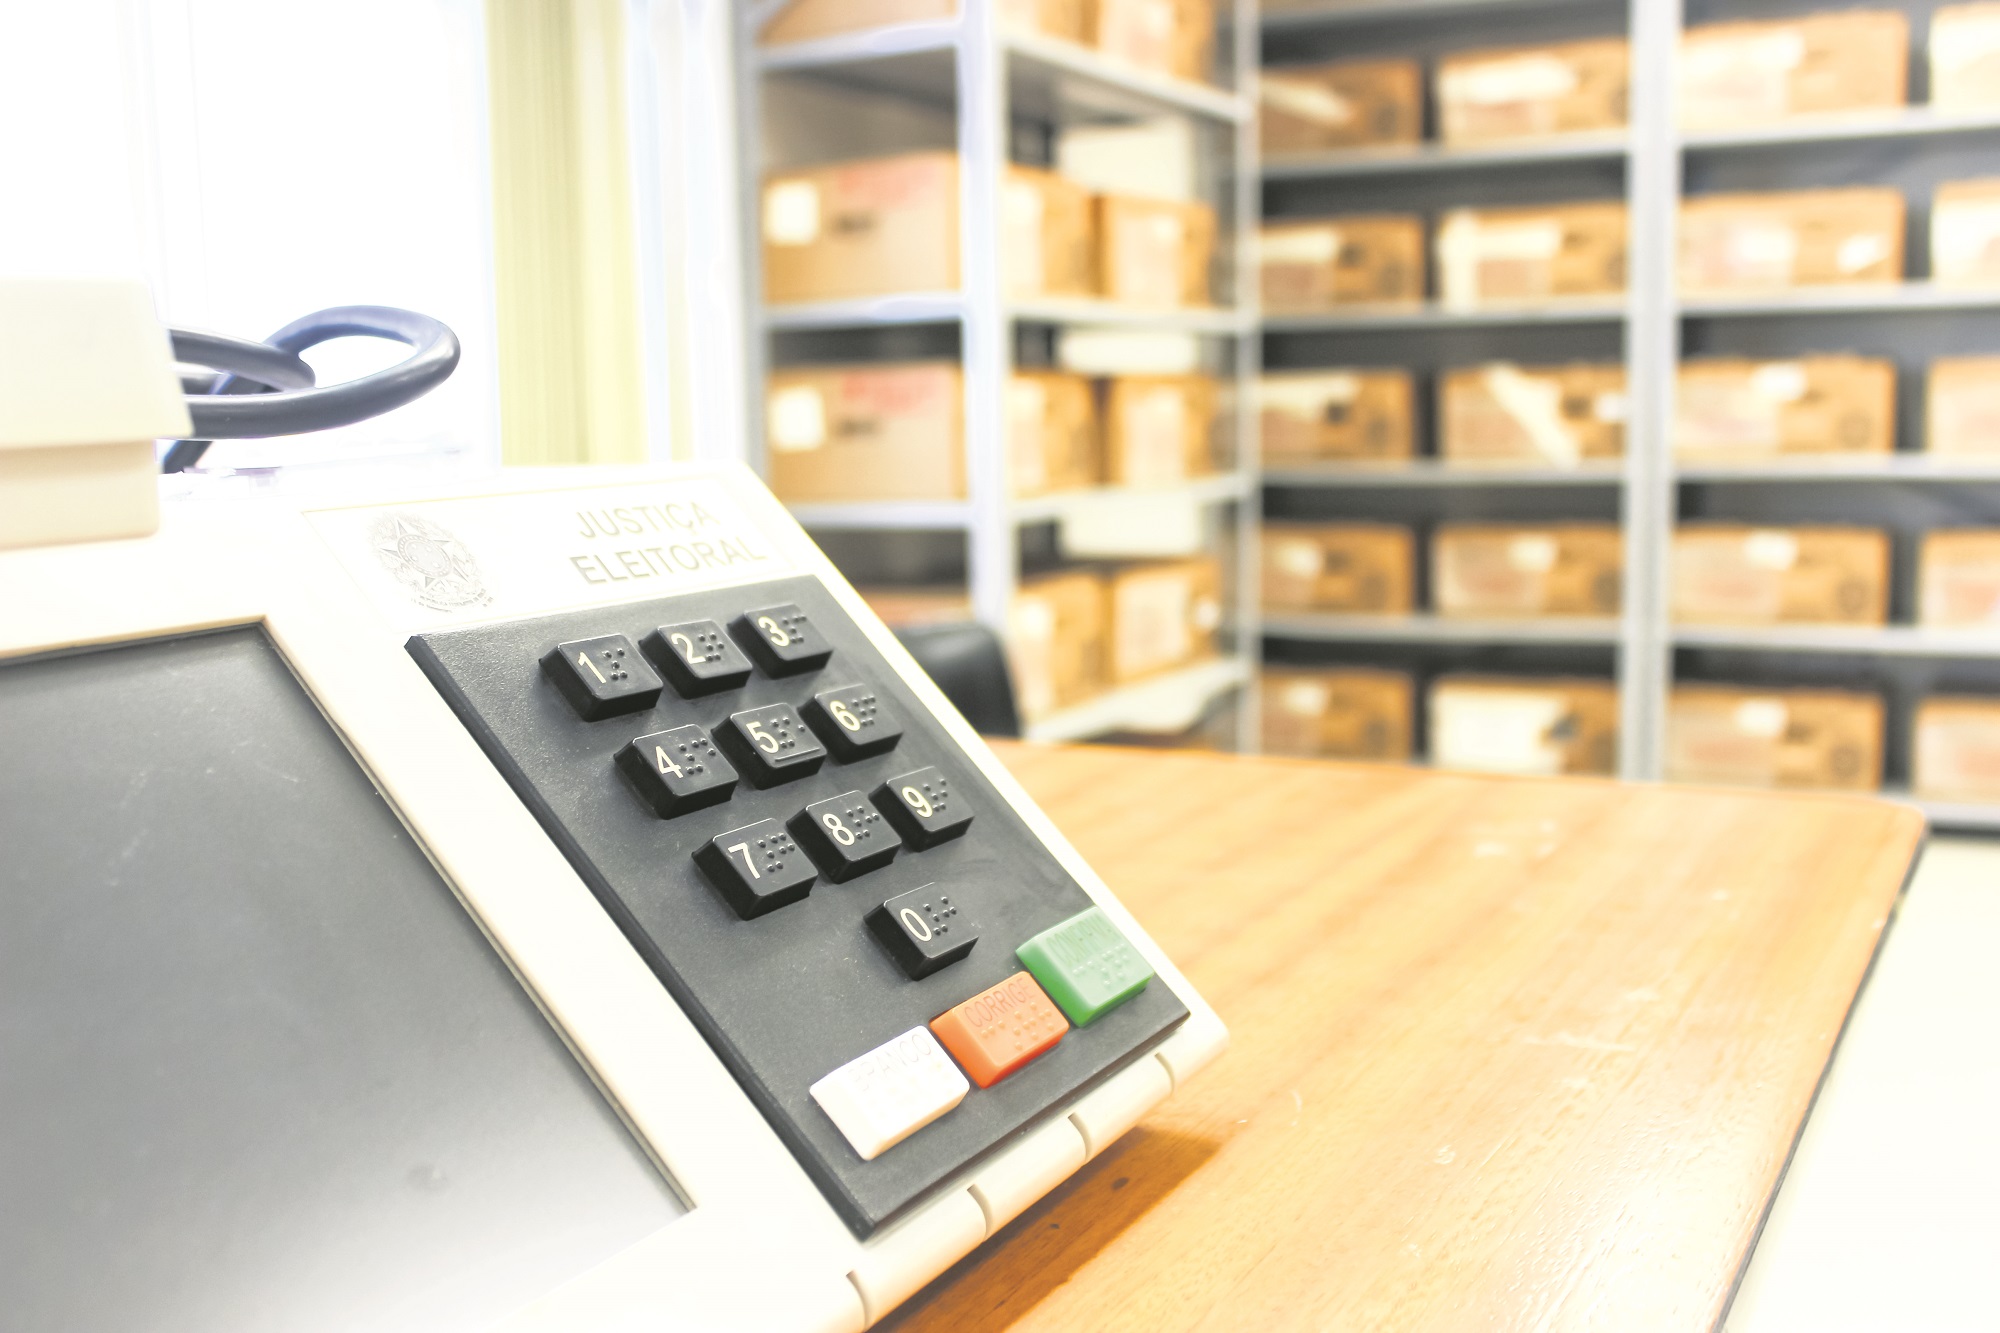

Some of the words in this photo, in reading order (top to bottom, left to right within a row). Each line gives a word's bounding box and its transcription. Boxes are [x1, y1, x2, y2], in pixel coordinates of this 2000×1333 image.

[575, 501, 722, 537] JUSTIÇA
[569, 535, 769, 585] ELEITORAL
[671, 632, 707, 664] 2
[758, 616, 790, 647] 3
[578, 651, 607, 684] 1
[829, 700, 861, 732] 6
[745, 721, 779, 754] 5
[655, 745, 685, 779] 4
[901, 785, 933, 818] 9
[822, 812, 855, 846] 8
[727, 841, 760, 879] 7
[899, 907, 932, 942] 0
[964, 977, 1036, 1028] CORRIGE
